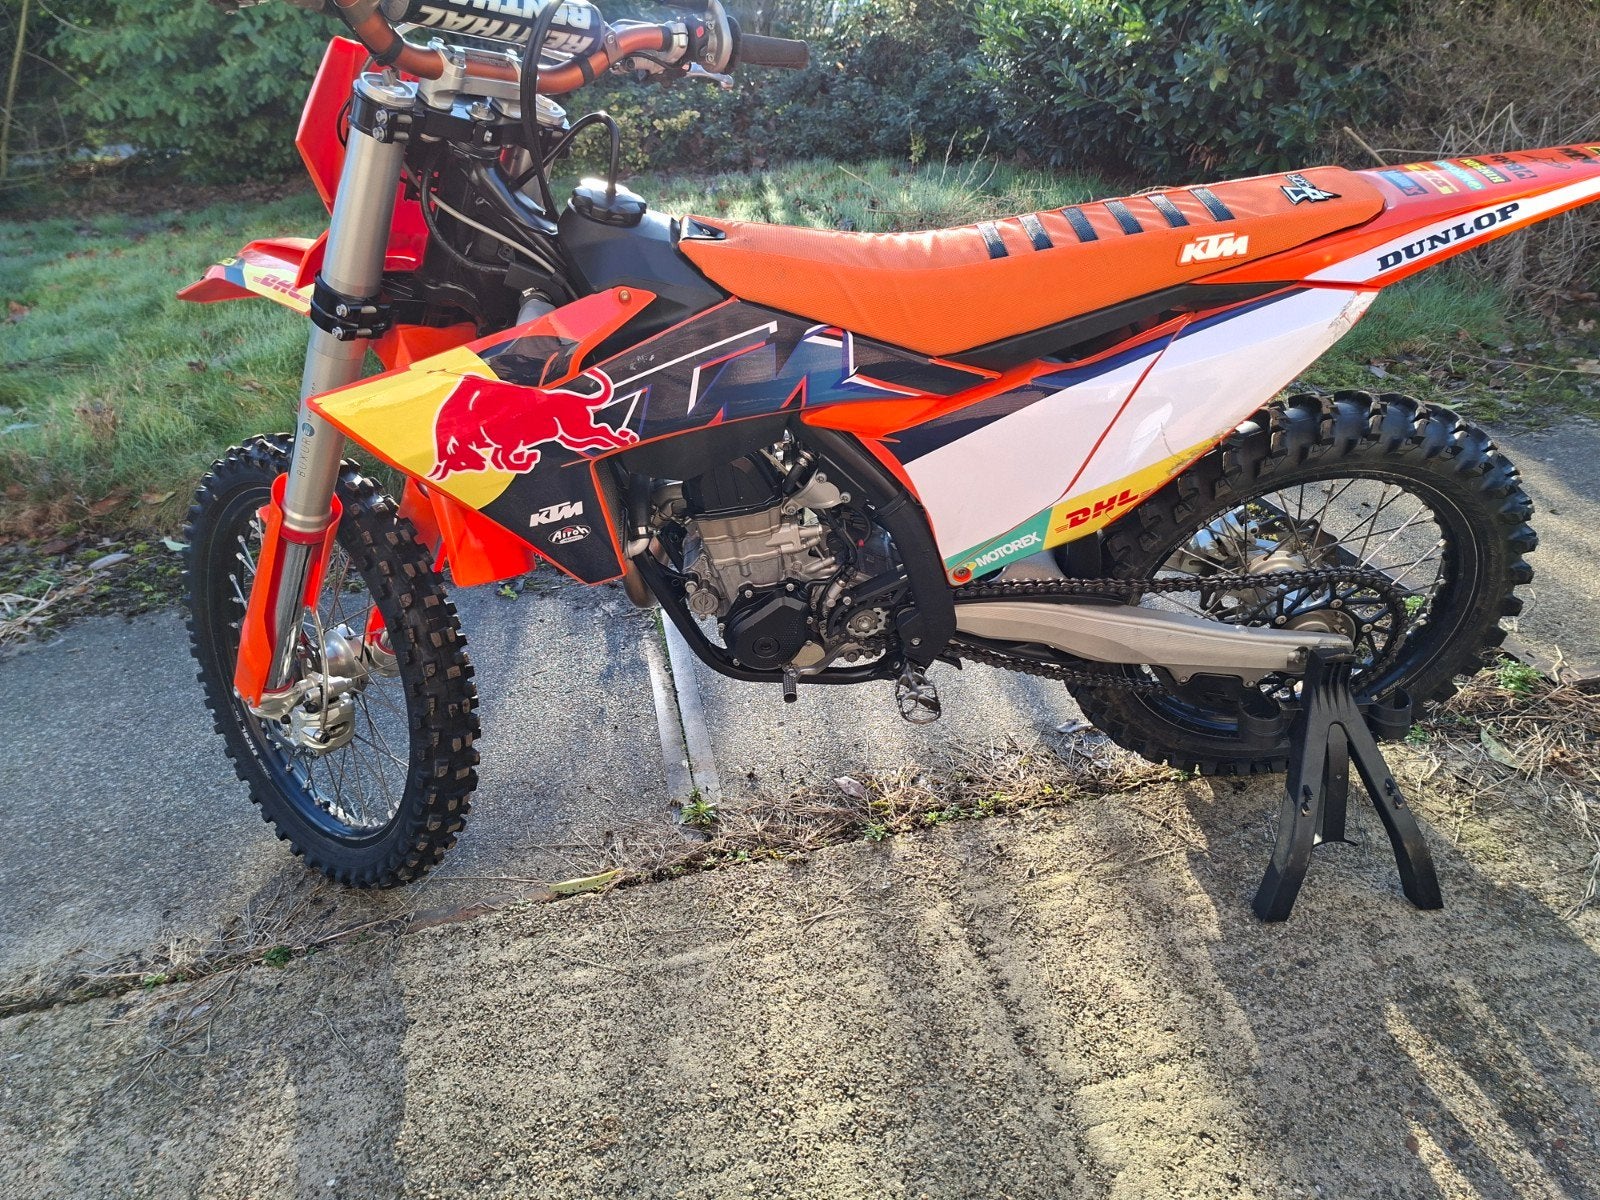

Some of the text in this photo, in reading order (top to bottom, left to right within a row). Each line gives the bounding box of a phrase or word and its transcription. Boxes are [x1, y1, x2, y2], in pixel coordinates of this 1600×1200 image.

[1180, 233, 1249, 263] KTM
[1377, 202, 1520, 271] DUNLOP
[529, 501, 584, 527] KTM
[1066, 489, 1138, 529] DHL
[551, 526, 589, 542] Airoh
[975, 531, 1042, 567] MOTOREX
